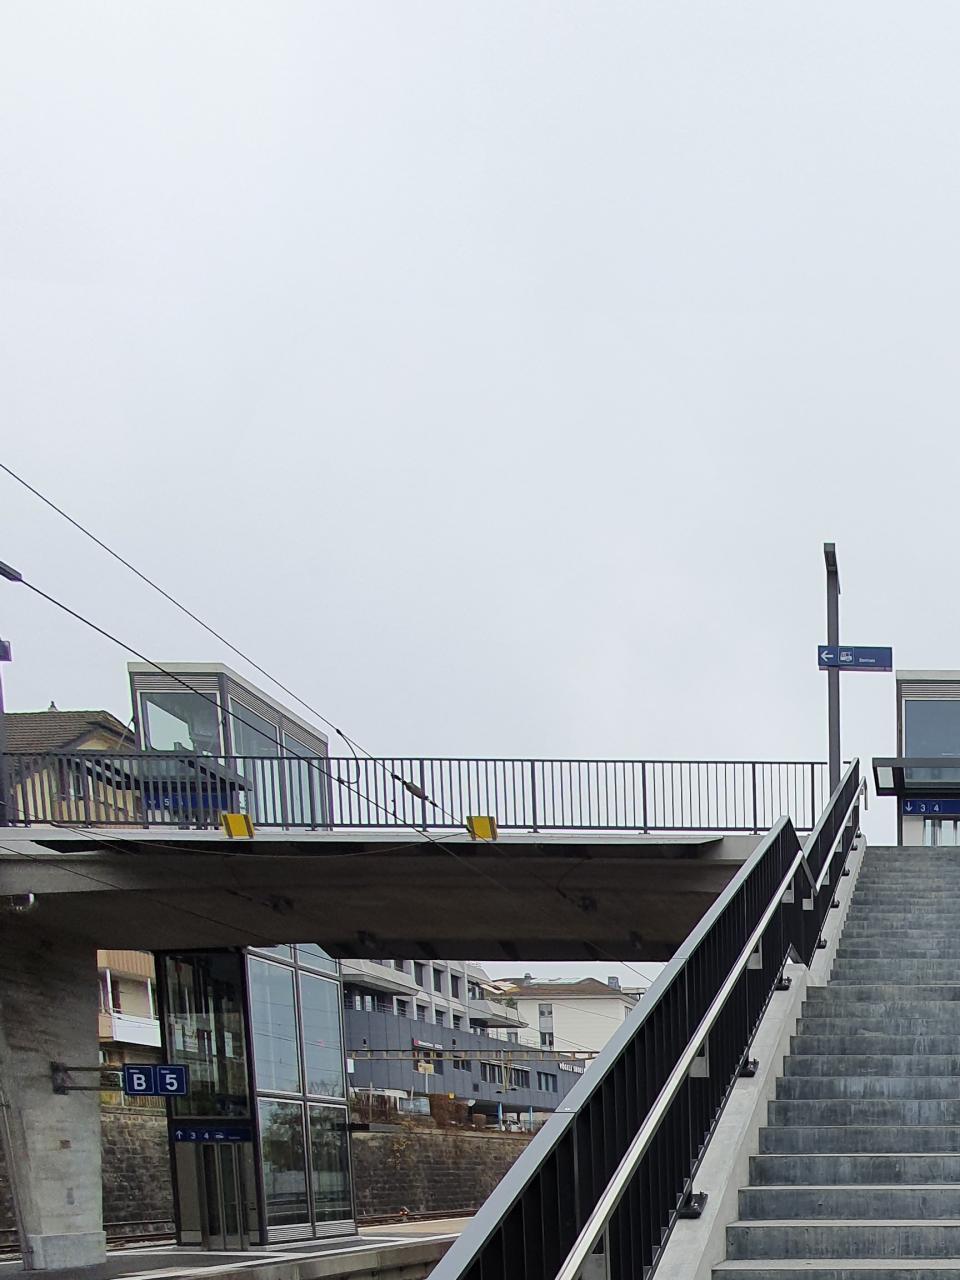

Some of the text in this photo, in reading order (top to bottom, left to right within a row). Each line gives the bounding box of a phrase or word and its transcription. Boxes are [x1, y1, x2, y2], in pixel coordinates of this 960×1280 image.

[164, 798, 170, 806] 5
[920, 804, 940, 812] 3 4
[133, 1074, 178, 1090] B 5
